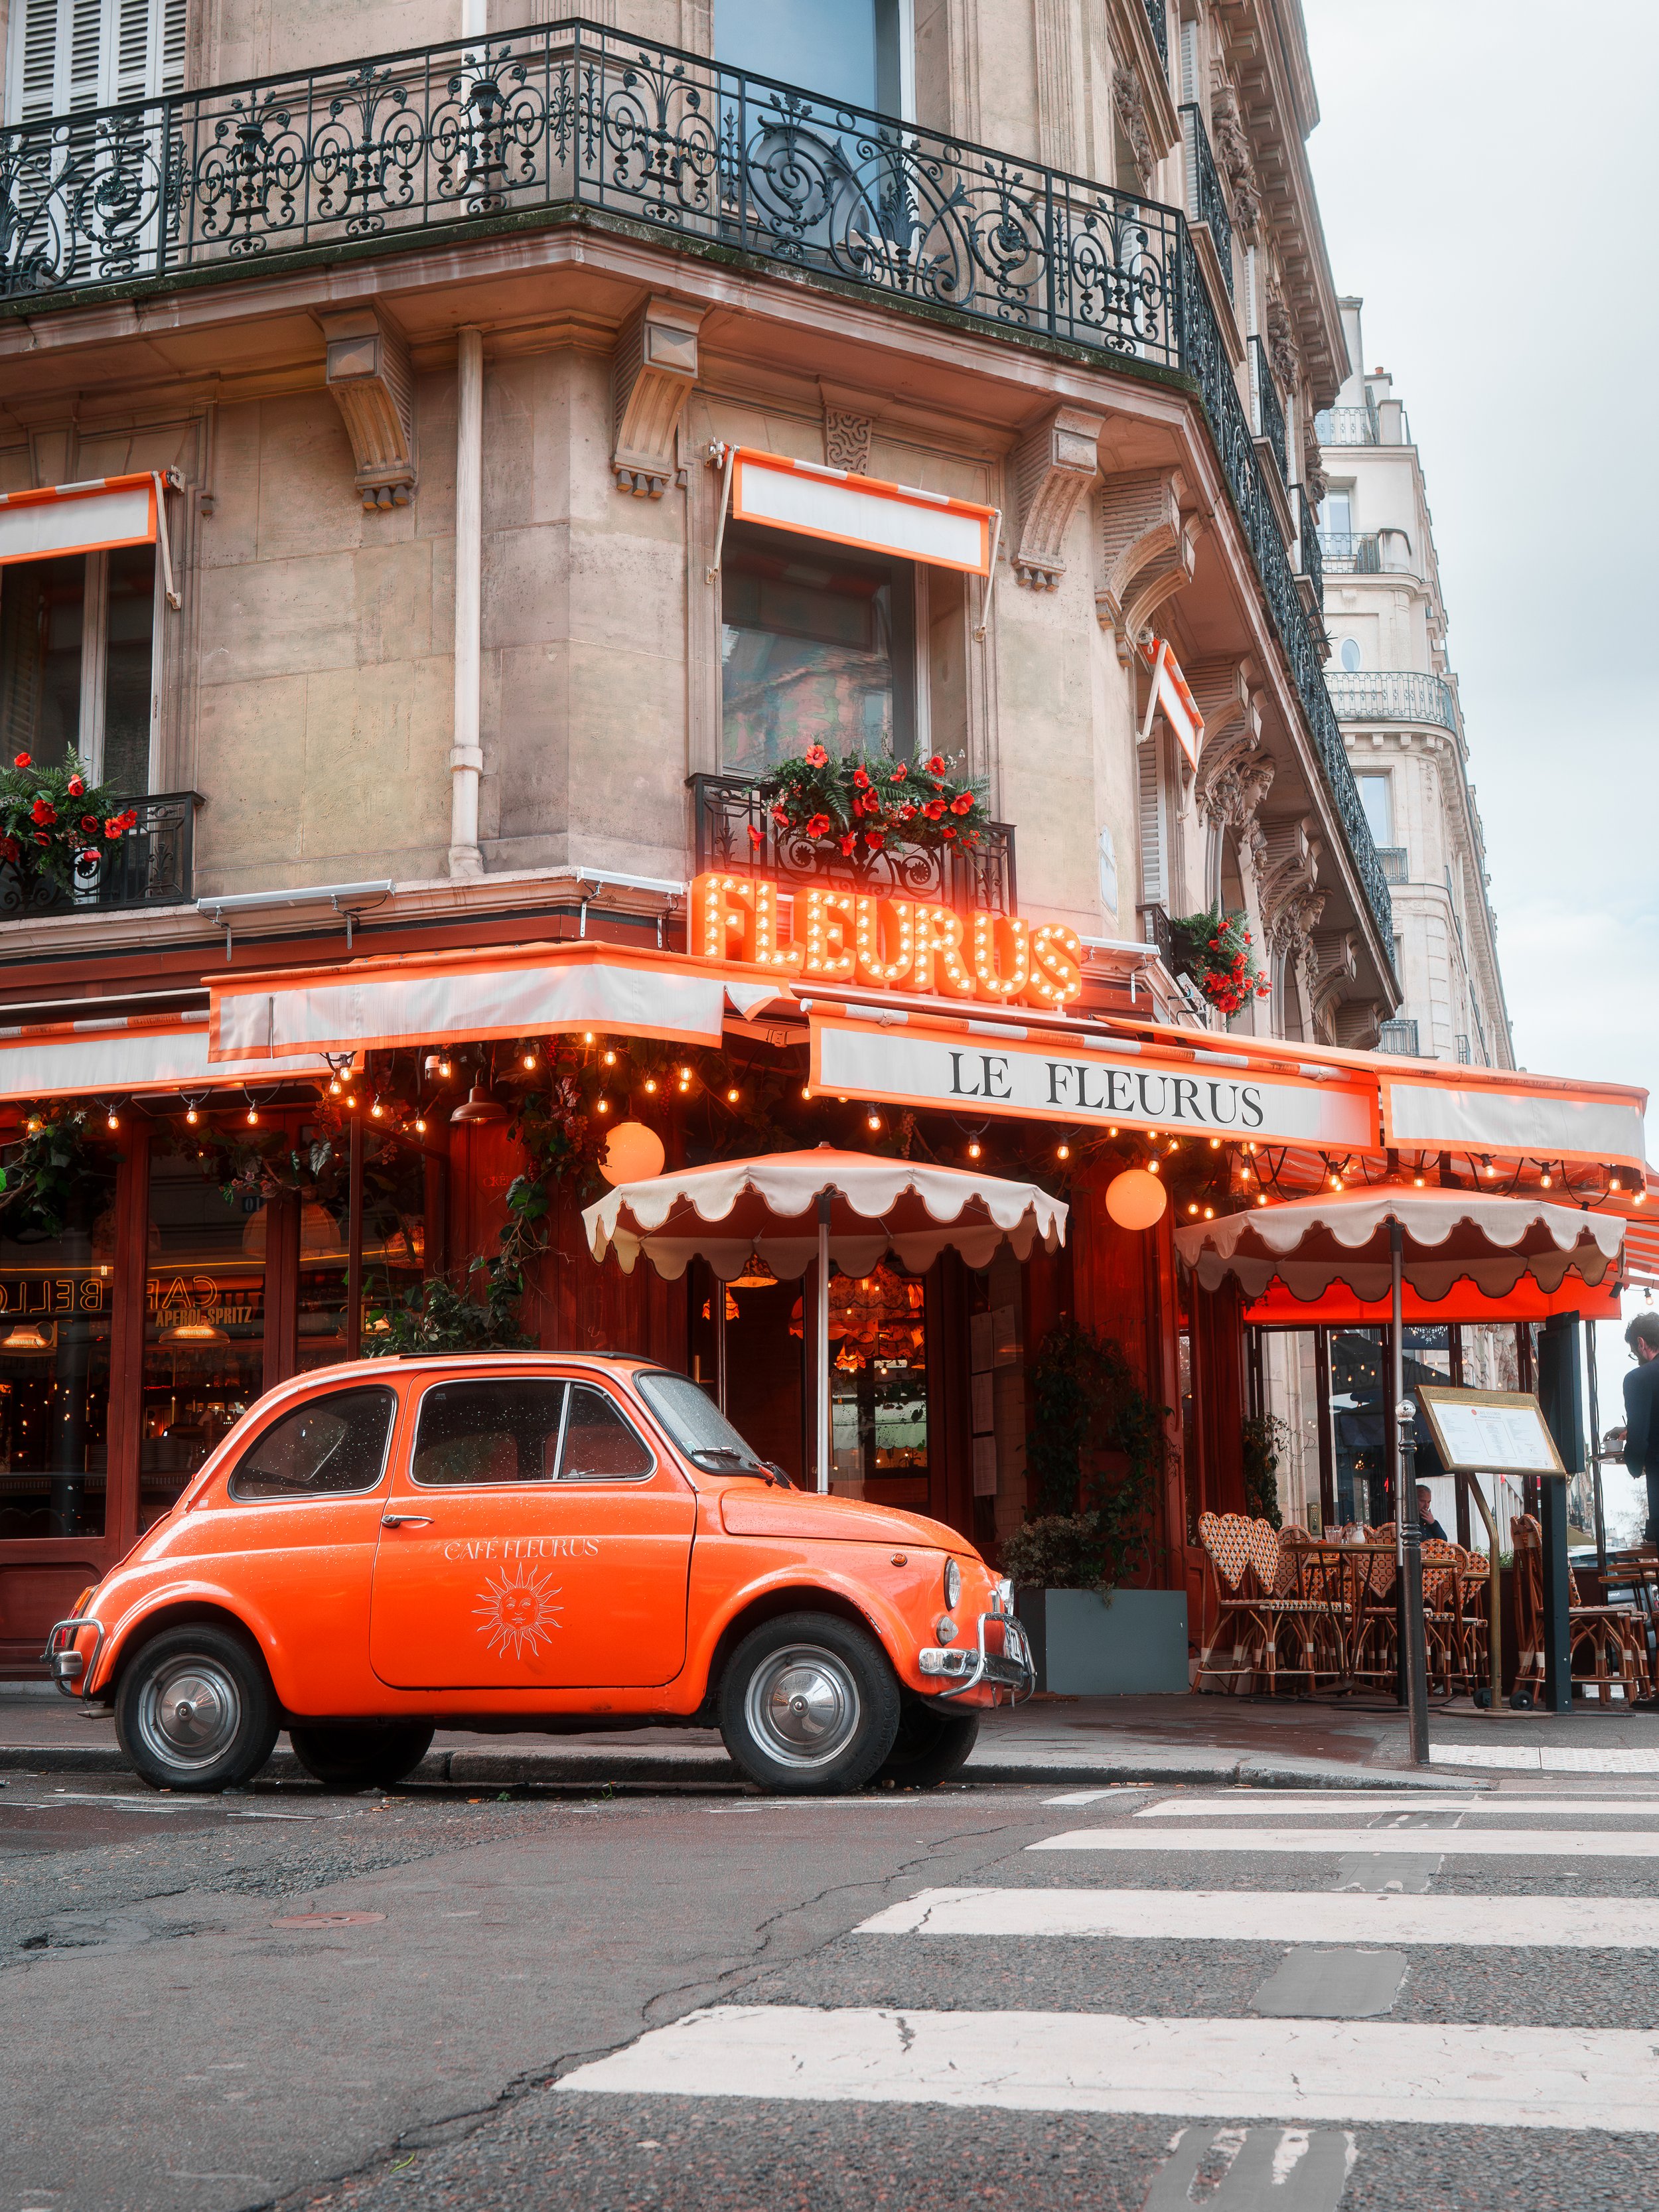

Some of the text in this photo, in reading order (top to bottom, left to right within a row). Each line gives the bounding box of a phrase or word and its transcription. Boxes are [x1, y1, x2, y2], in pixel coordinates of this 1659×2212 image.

[691, 871, 1082, 1008] FLEURUS
[948, 1051, 1263, 1127] LE FLEURUS
[155, 1306, 253, 1327] APEROL SPRITZ
[445, 1536, 600, 1560] CAFÉ FLEURUS
